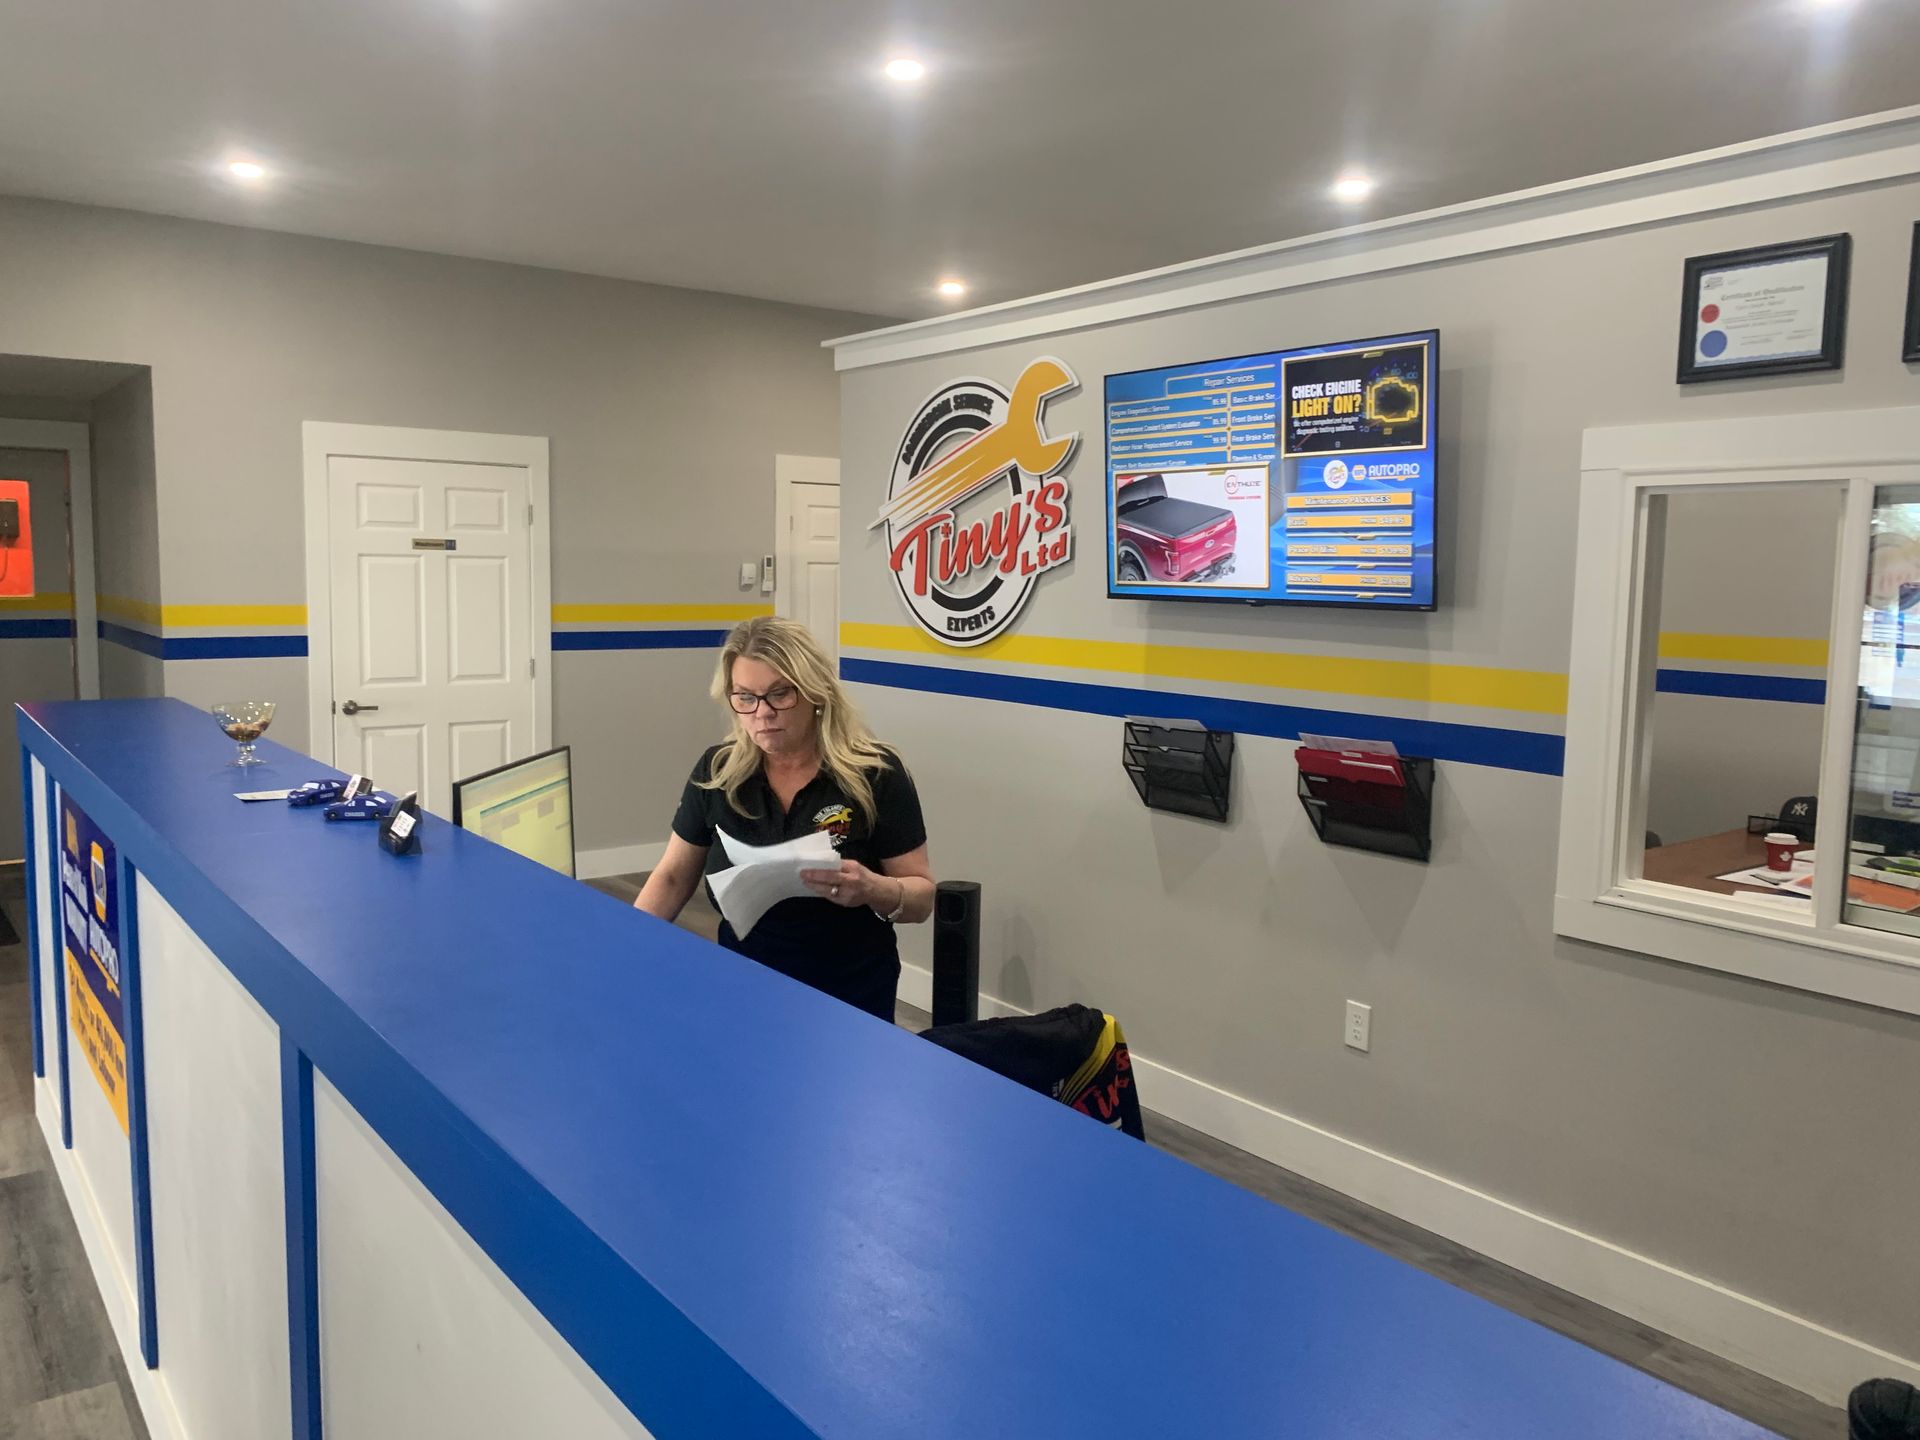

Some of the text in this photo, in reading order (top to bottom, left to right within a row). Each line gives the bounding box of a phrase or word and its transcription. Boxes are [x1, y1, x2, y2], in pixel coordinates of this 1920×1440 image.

[1204, 374, 1255, 388] Repair Services
[1292, 379, 1362, 399] CHECK ENGINE
[1248, 393, 1265, 402] Brake
[1292, 394, 1362, 418] LIGHT ON?
[1247, 414, 1263, 422] Brake
[1245, 433, 1261, 442] Brake
[1368, 463, 1420, 476] AUTOPRO
[1348, 495, 1391, 504] PACKAGES
[1020, 532, 1068, 577] Ltd
[947, 605, 995, 632] EXPERTS
